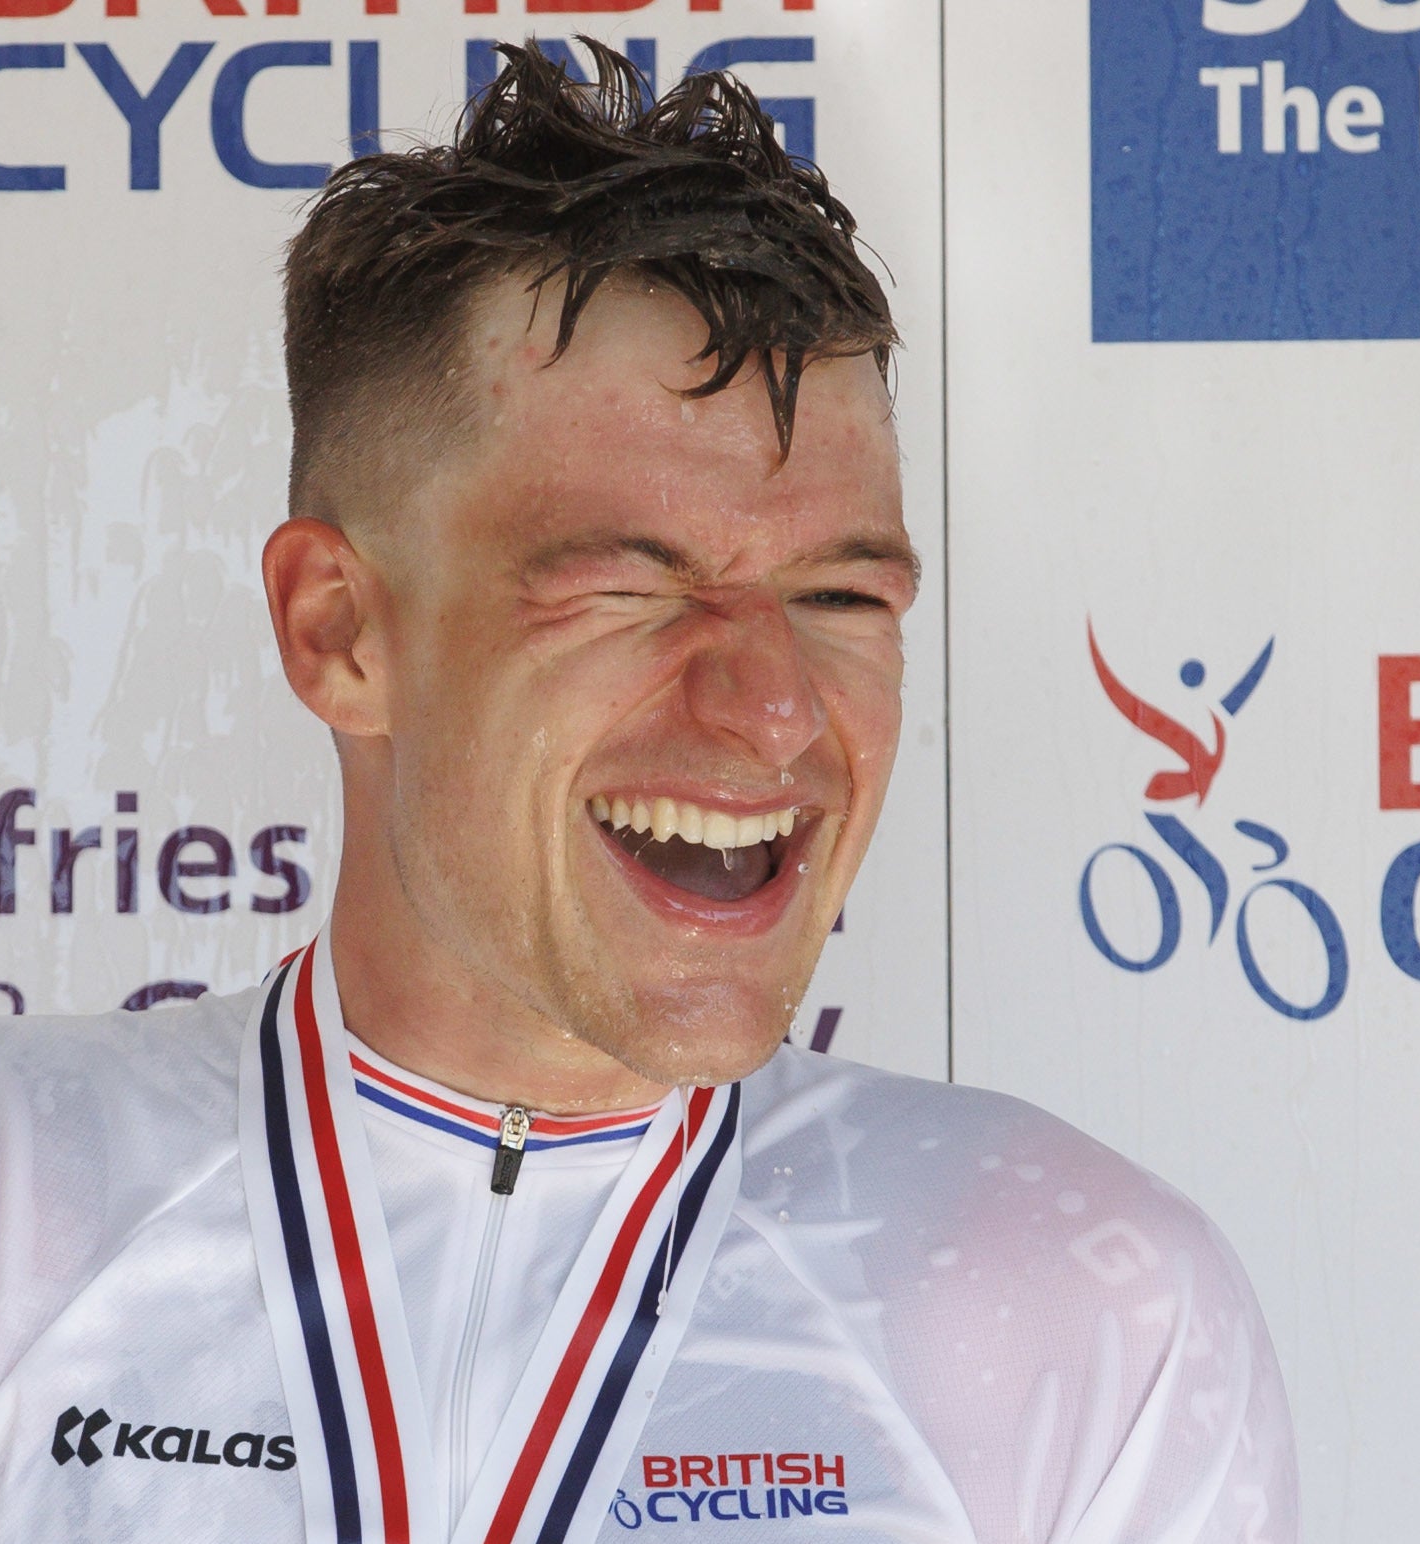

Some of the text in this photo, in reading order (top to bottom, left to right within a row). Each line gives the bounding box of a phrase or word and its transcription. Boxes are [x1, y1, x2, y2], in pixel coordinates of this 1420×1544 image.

[1199, 61, 1384, 154] The
[642, 1453, 845, 1488] BRITISH
[647, 1488, 849, 1523] CYCLING
